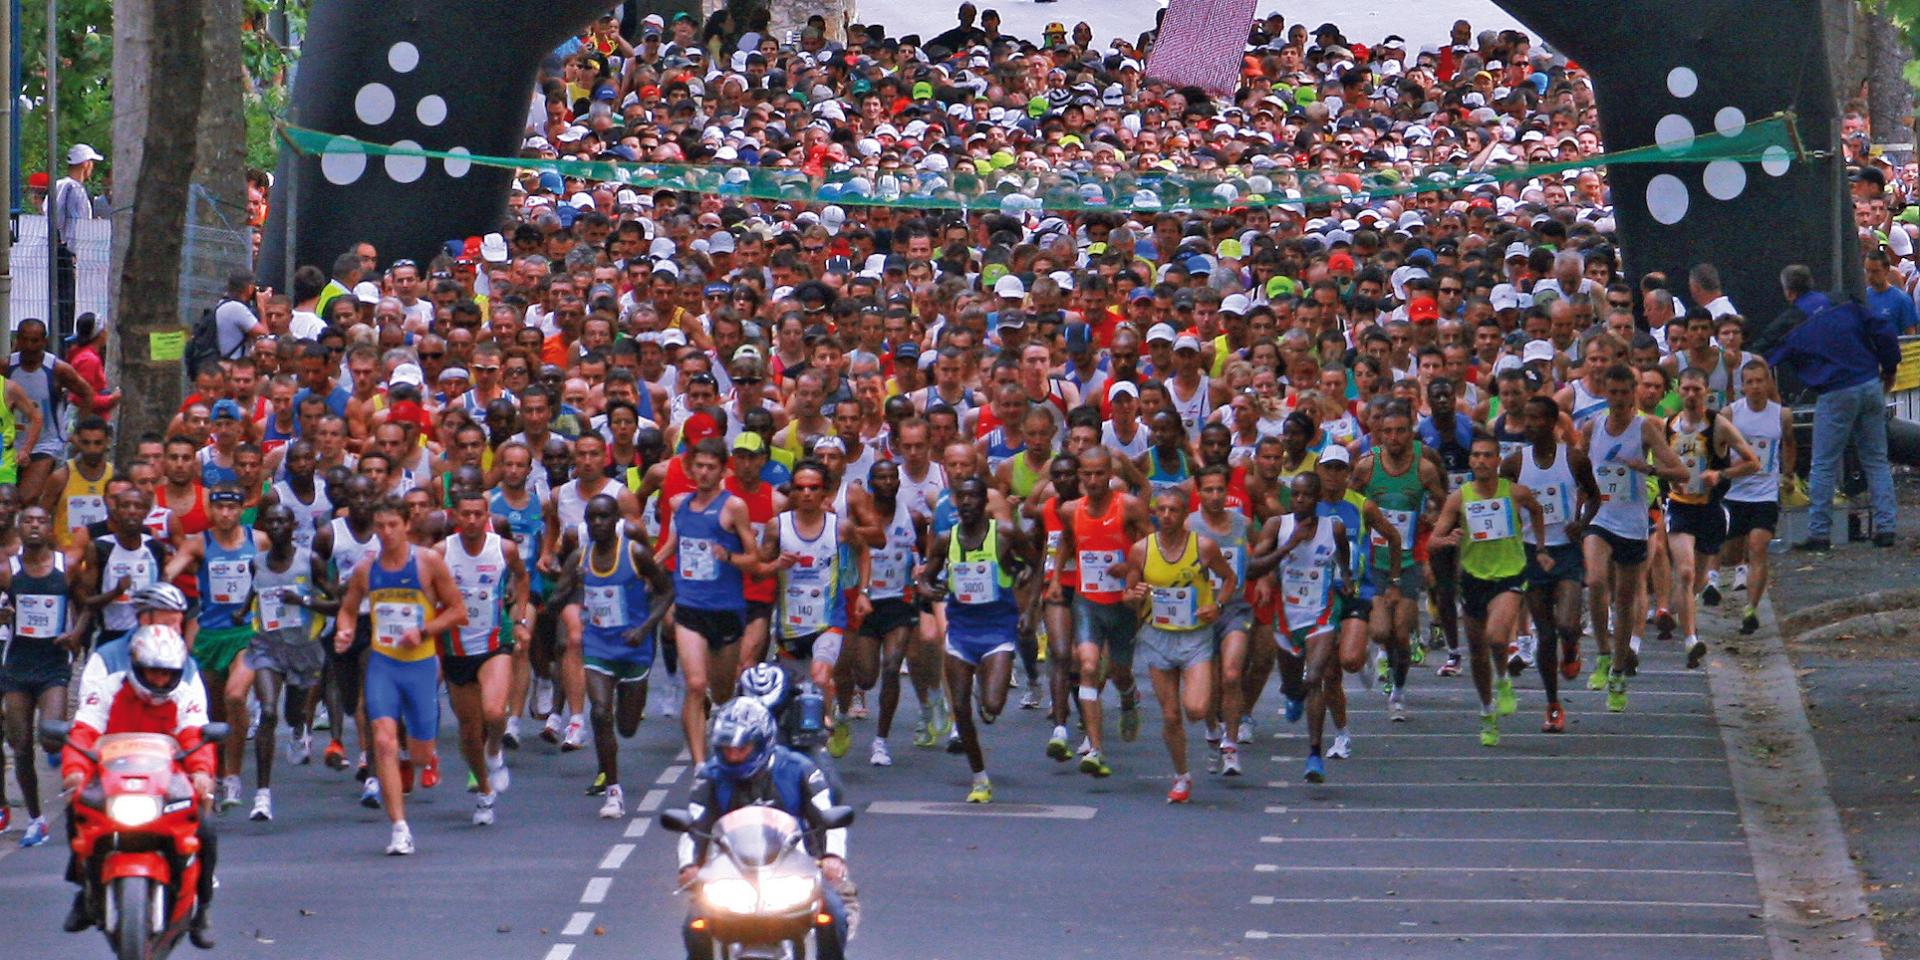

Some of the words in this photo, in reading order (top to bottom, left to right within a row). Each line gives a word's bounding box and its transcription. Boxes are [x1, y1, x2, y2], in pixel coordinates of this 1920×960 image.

[1608, 483, 1616, 493] 77
[1484, 519, 1493, 530] 51
[1098, 571, 1103, 581] 2
[227, 581, 237, 592] 25
[798, 605, 813, 616] 140
[1168, 606, 1176, 616] 10
